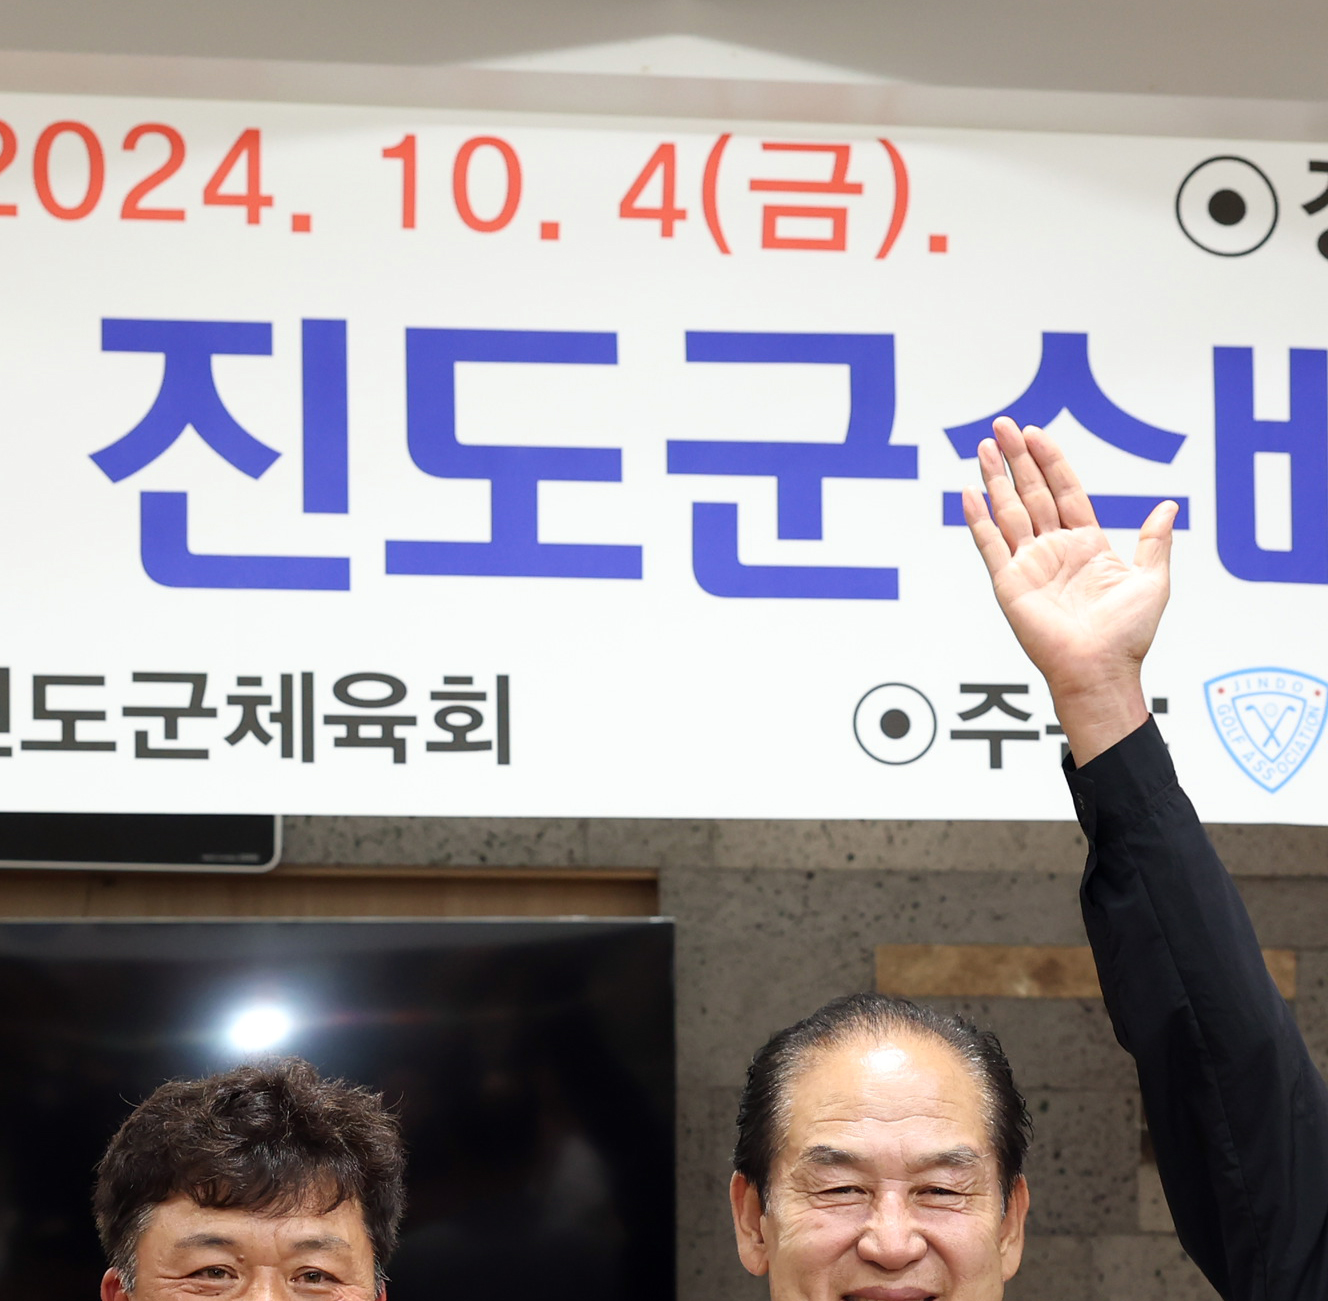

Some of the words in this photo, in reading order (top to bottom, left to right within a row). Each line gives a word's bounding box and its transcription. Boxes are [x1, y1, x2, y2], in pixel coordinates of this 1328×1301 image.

[383, 135, 559, 240] 10.
[620, 133, 947, 258] 4(금).
[1234, 677, 1304, 693] JINDO
[1217, 704, 1245, 744] GOLF
[1242, 706, 1321, 780] ASSOCIATION
